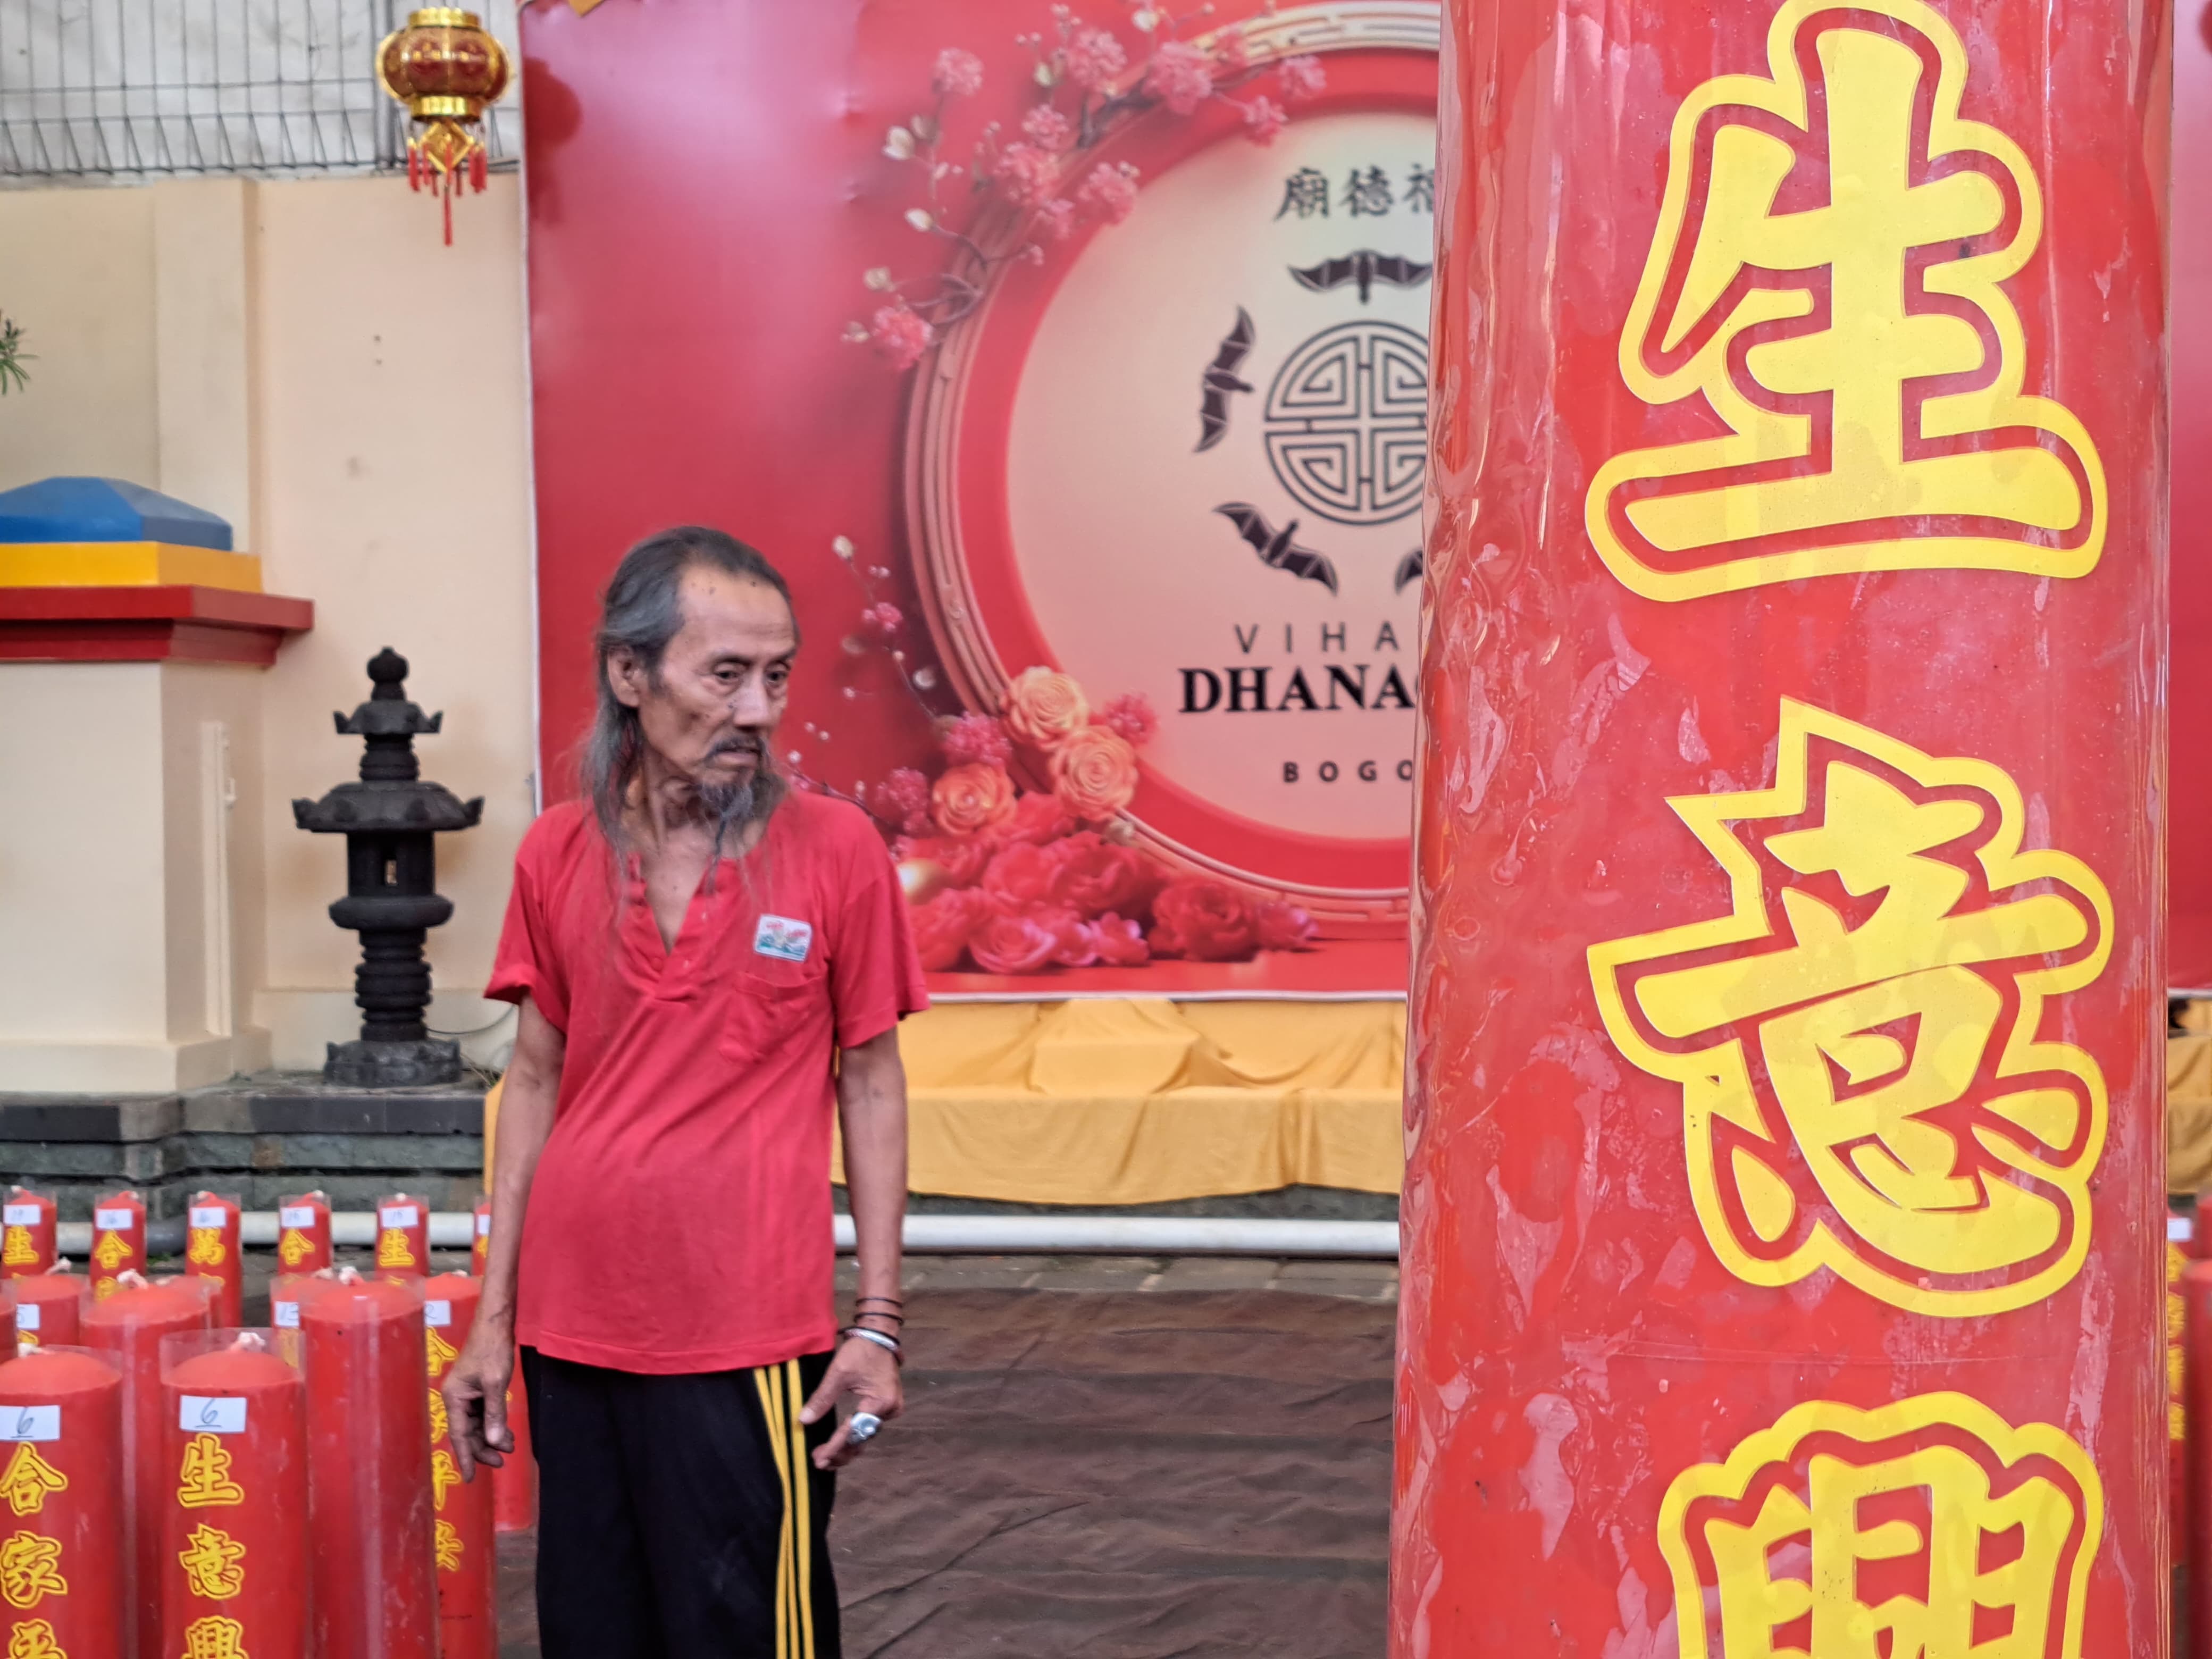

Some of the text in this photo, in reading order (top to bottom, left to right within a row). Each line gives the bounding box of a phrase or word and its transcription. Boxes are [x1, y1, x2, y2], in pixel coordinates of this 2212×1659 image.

[1178, 664, 1418, 713] DHANA
[1283, 760, 1412, 783] BOGO
[201, 1398, 219, 1425] 6
